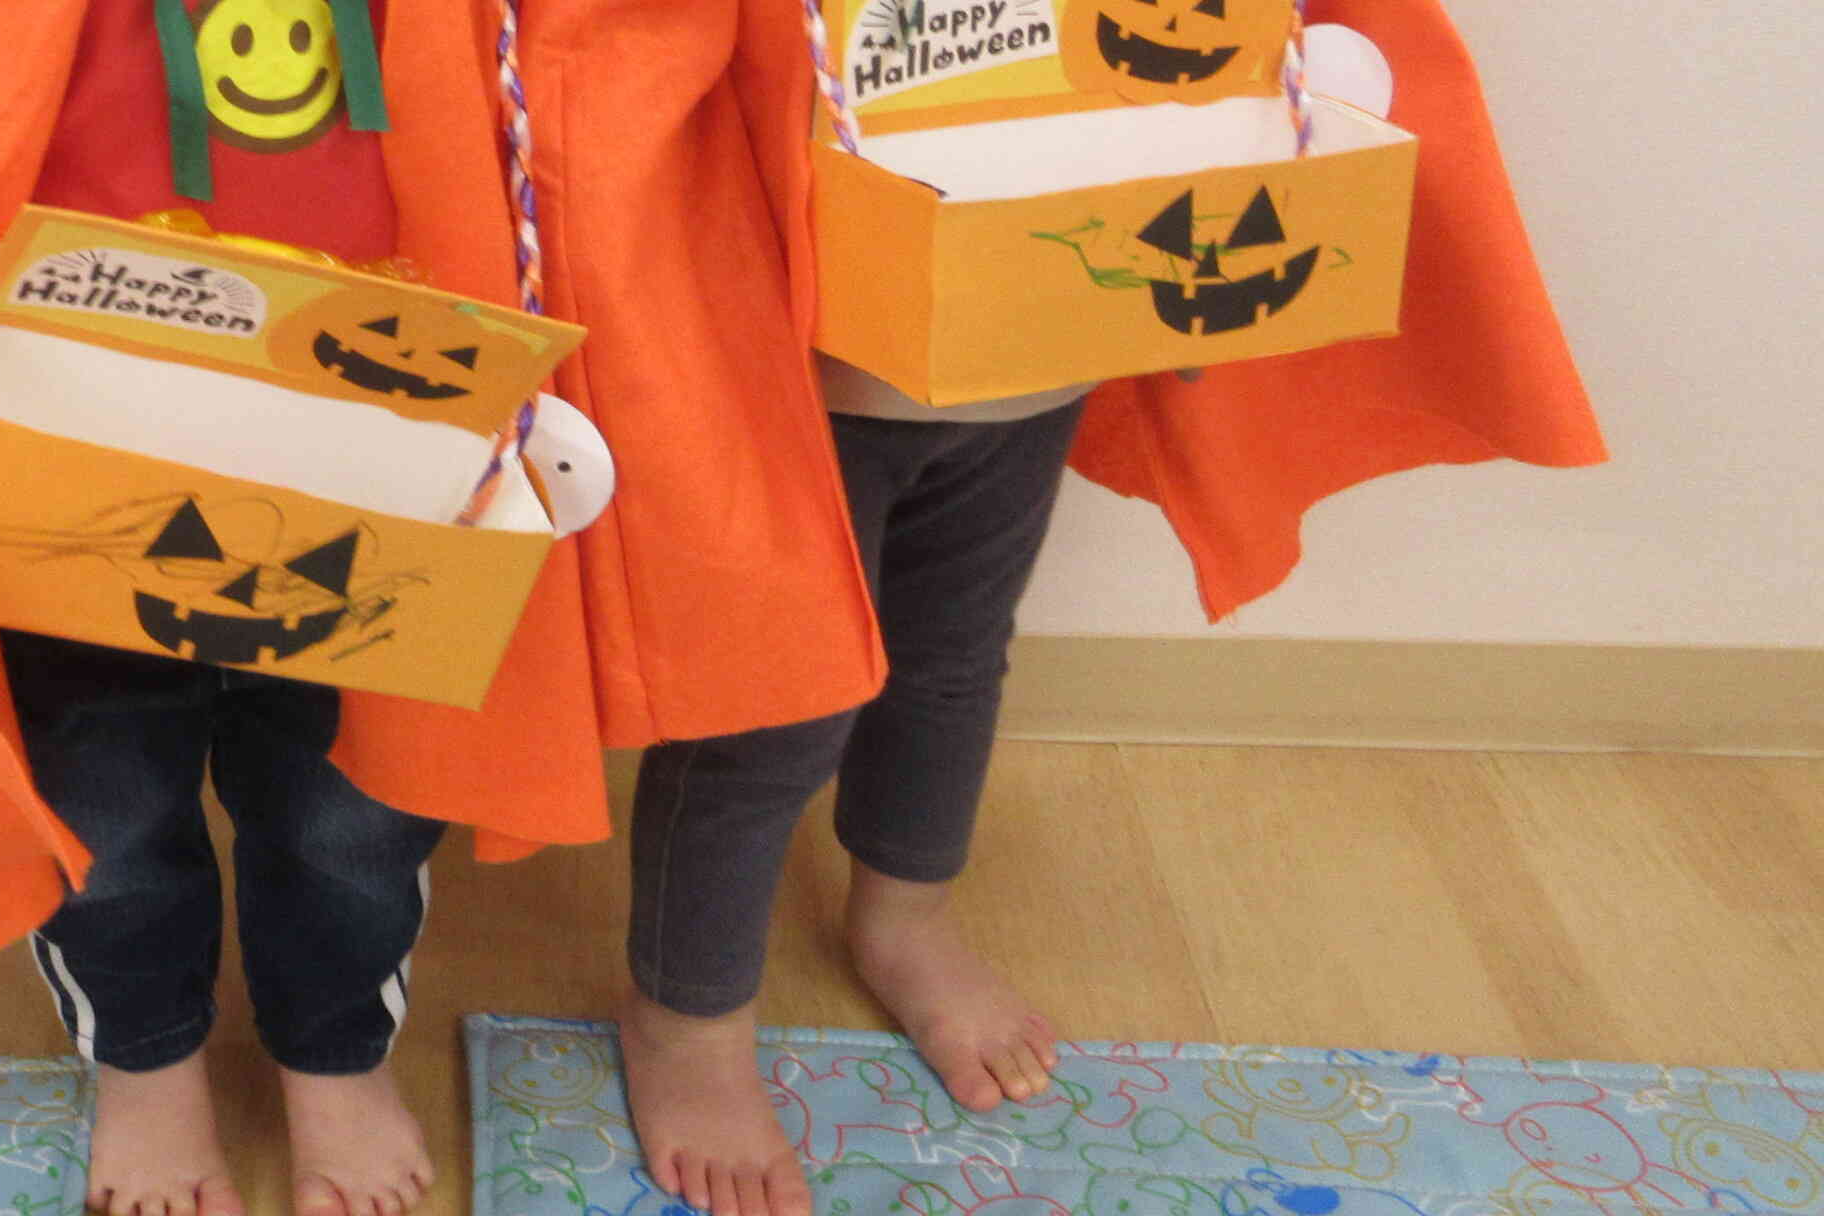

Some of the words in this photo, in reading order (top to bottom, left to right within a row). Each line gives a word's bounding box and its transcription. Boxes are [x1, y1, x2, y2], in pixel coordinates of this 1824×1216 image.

[898, 0, 1006, 39] Happy
[854, 21, 1051, 97] Halloween
[17, 281, 256, 332] Halloween
[91, 264, 218, 305] Happy
